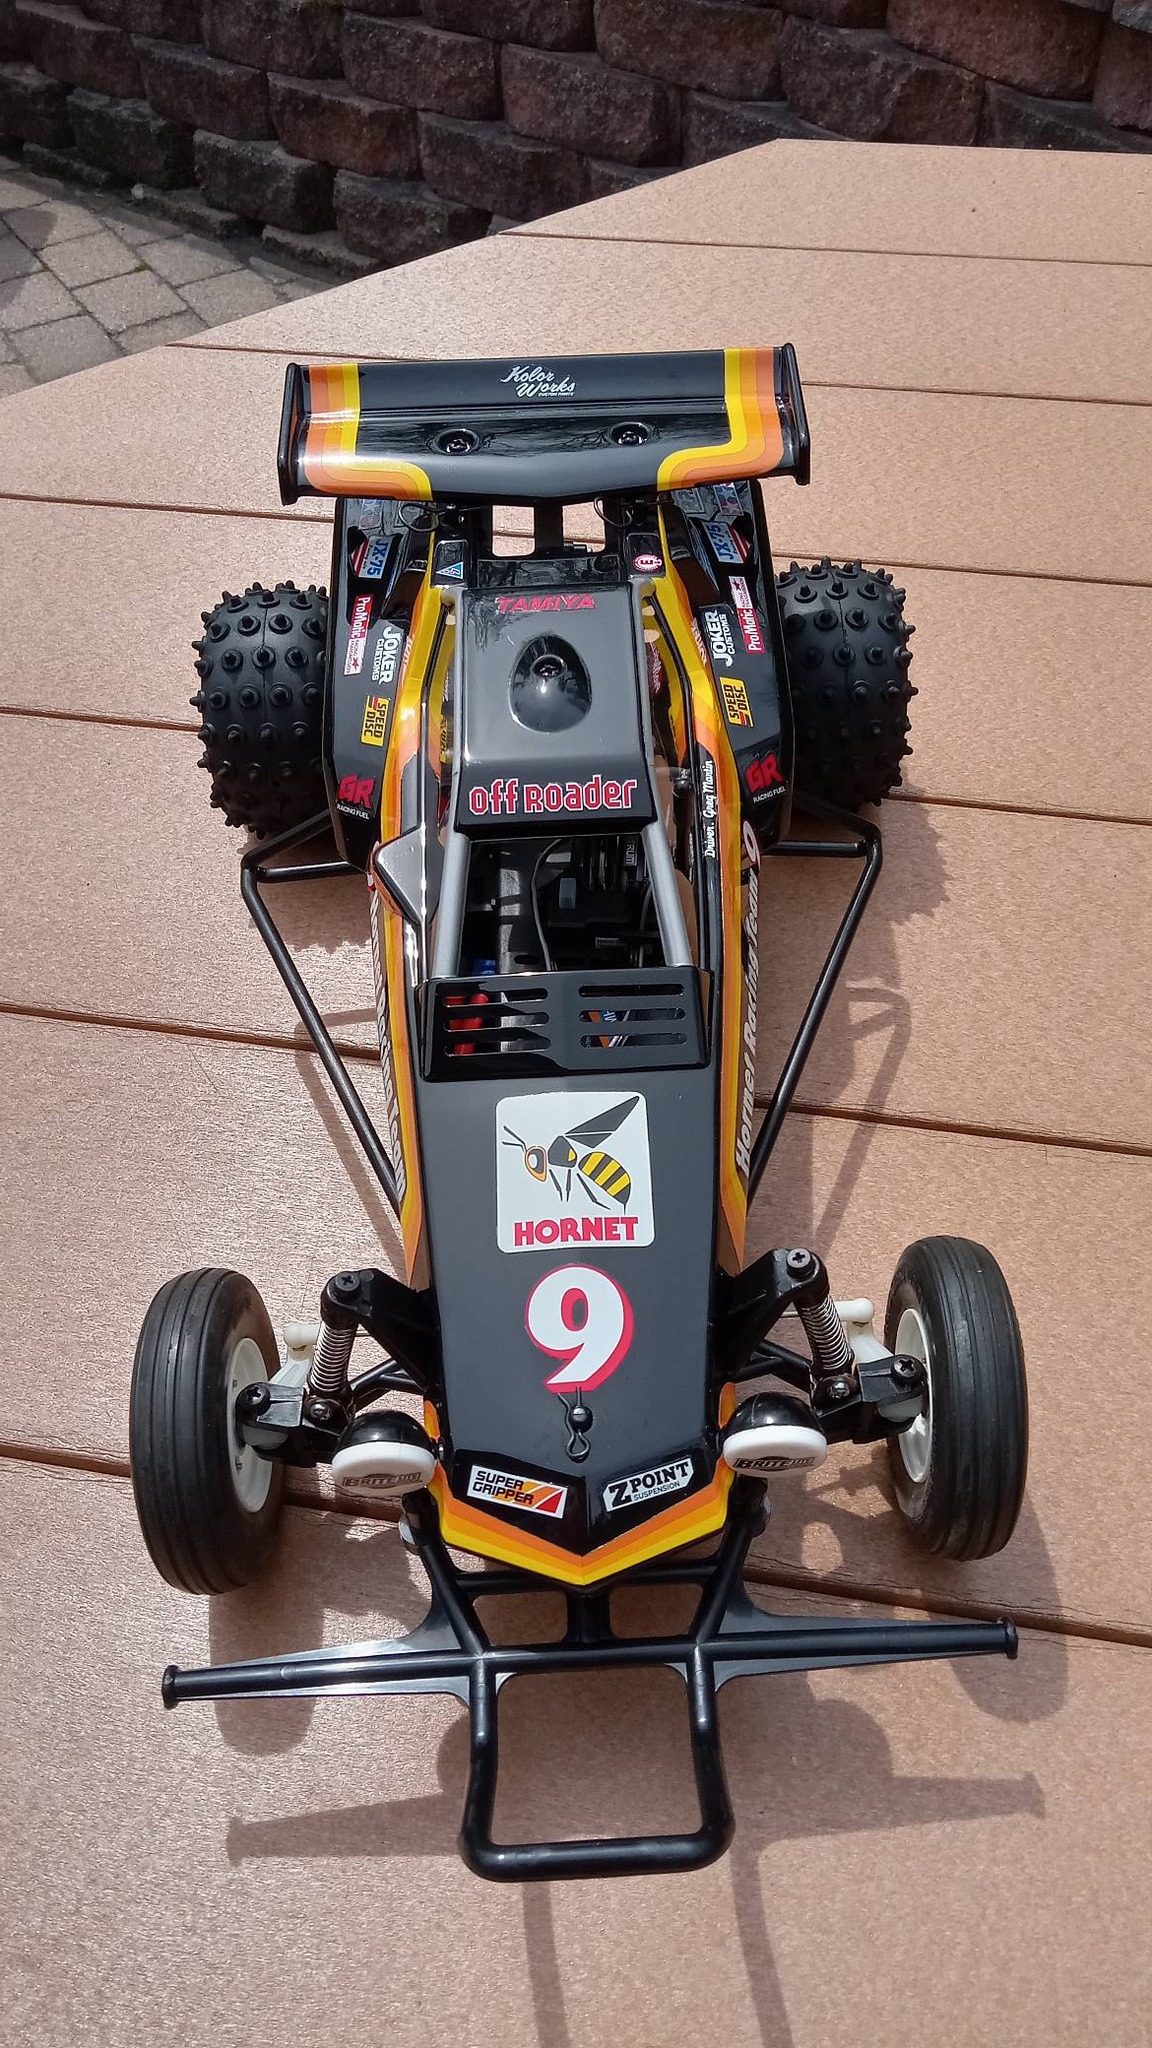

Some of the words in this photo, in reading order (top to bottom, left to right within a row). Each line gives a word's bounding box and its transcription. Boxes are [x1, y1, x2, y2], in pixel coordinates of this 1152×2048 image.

[501, 365, 554, 382] Kolor
[516, 377, 576, 397] Works
[367, 540, 388, 576] JX-75
[706, 525, 734, 560] JX-75
[351, 596, 371, 638] ProMatic
[496, 594, 596, 613] TAMIYA
[704, 610, 734, 667] JOKER
[719, 614, 736, 655] CUSTOMS
[740, 609, 762, 651] ProMatic
[372, 638, 384, 681] CUSTOMS
[379, 626, 402, 685] JOKER
[724, 684, 740, 720] SPEED
[734, 685, 748, 711] DISC
[364, 711, 375, 737] DISC
[374, 702, 386, 739] SPEED
[700, 760, 714, 794] Martin
[746, 752, 784, 793] GR
[338, 774, 375, 809] GR
[702, 794, 718, 818] Greg
[752, 791, 774, 804] RACING
[773, 786, 786, 797] FUEL
[337, 804, 356, 816] RACING
[356, 808, 370, 820] FUEL
[744, 868, 758, 948] Team
[744, 943, 758, 1056] Racing
[736, 1052, 754, 1178] Hornet
[387, 1098, 406, 1200] Team
[514, 1216, 638, 1246] HORNET
[524, 1263, 634, 1394] 9
[472, 1482, 534, 1504] GRIPPER
[475, 1470, 524, 1490] SUPER
[634, 1480, 680, 1501] SUSPENSION
